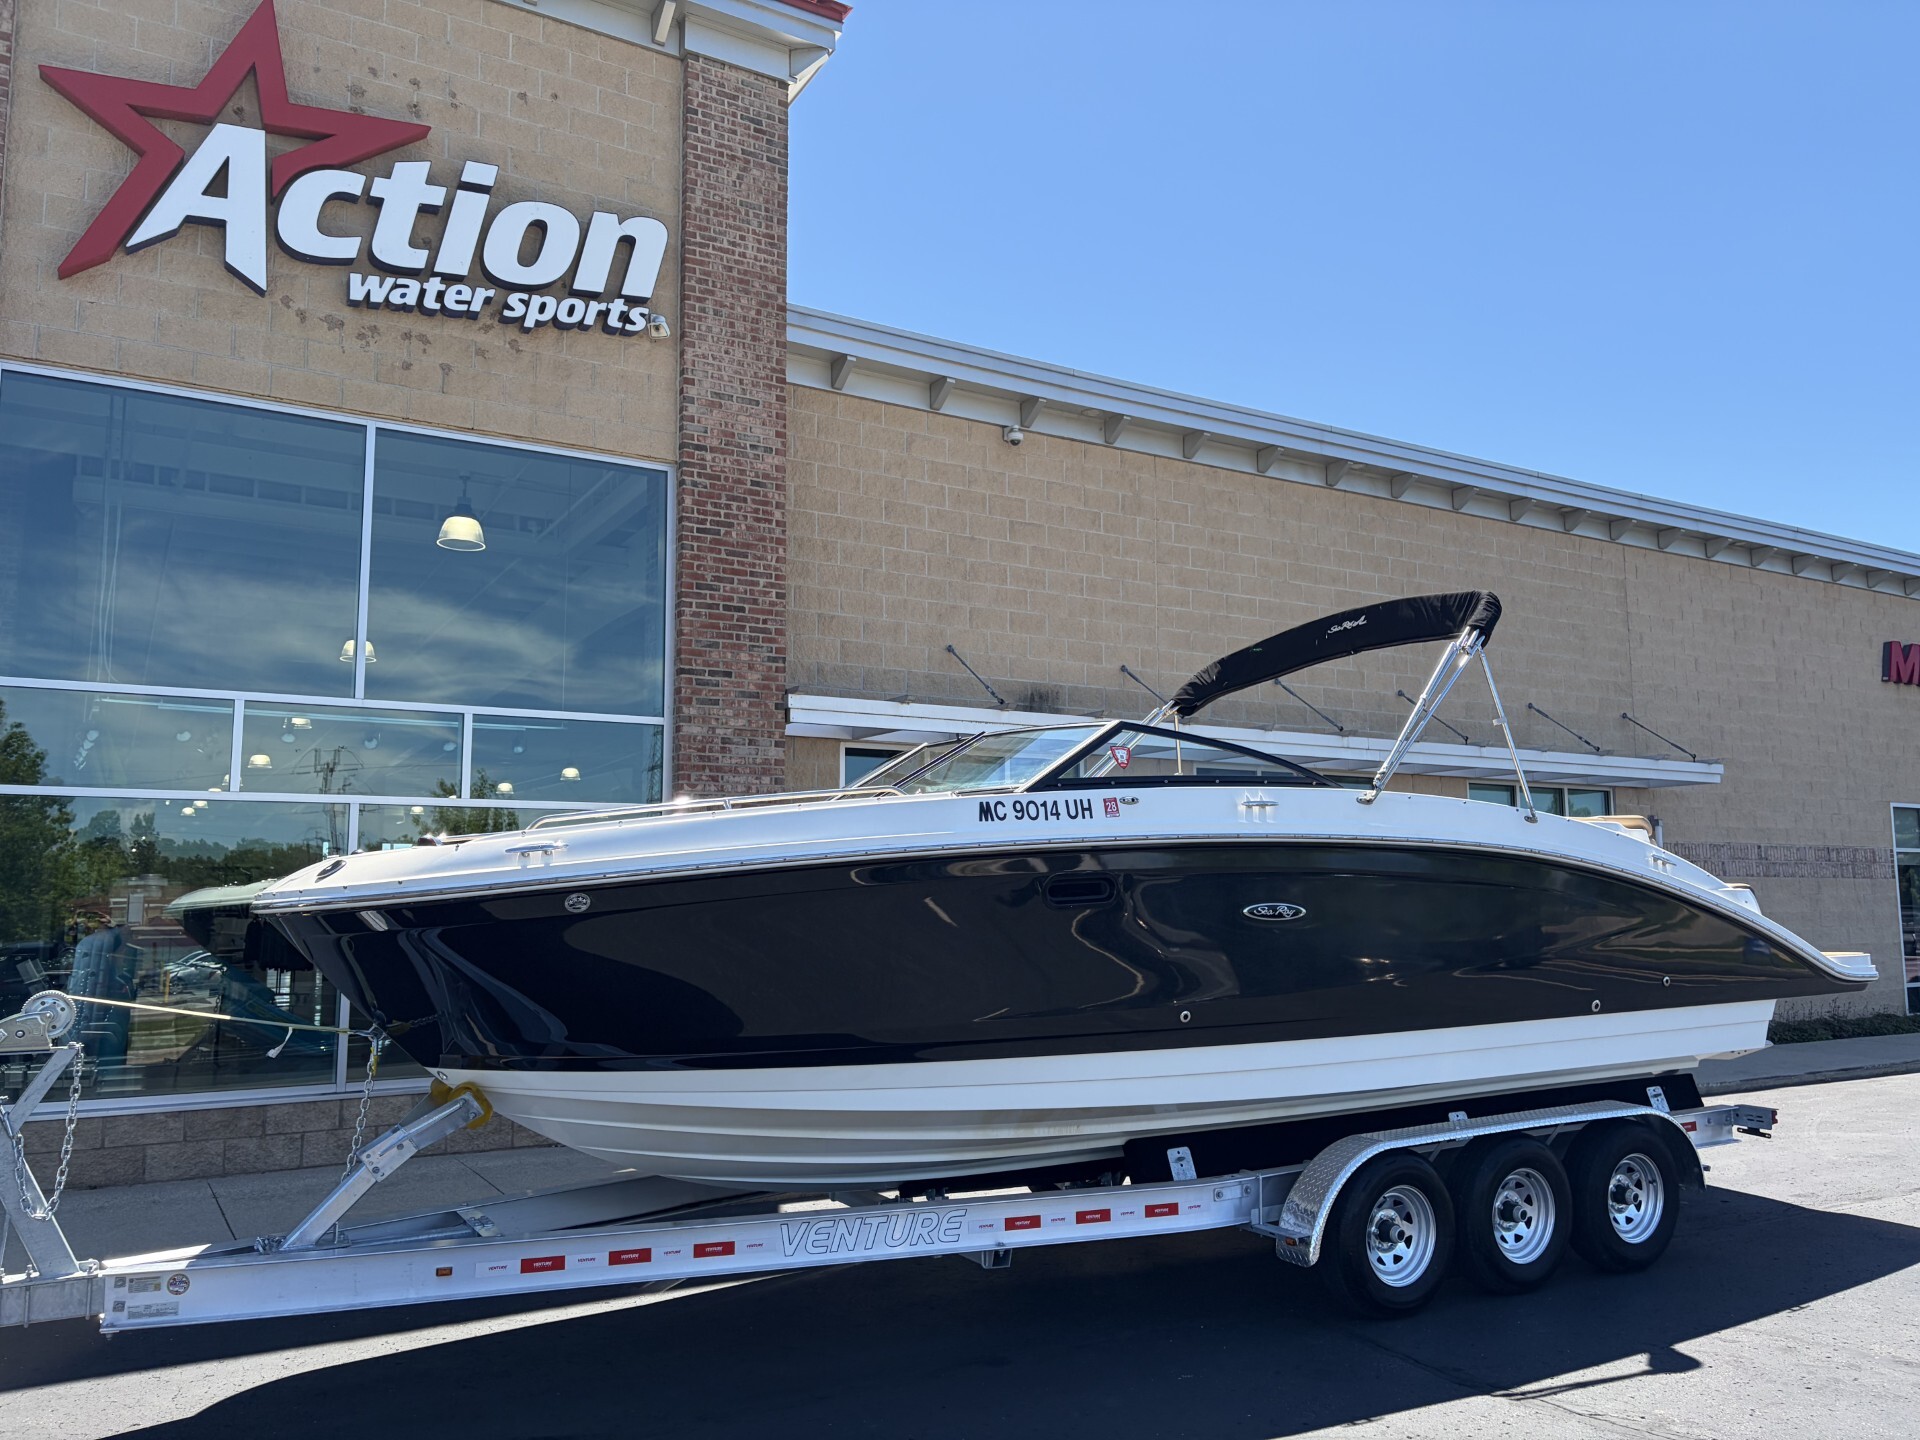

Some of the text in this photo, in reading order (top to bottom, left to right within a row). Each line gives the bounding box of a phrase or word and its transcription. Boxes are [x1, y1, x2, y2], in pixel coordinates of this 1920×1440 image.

[126, 122, 669, 297] Action
[348, 272, 650, 335] water sports
[979, 798, 1093, 822] MC 9014 UH
[1106, 801, 1117, 812] 28
[1254, 905, 1296, 918] Sea Ray
[780, 1209, 967, 1257] VENTURE
